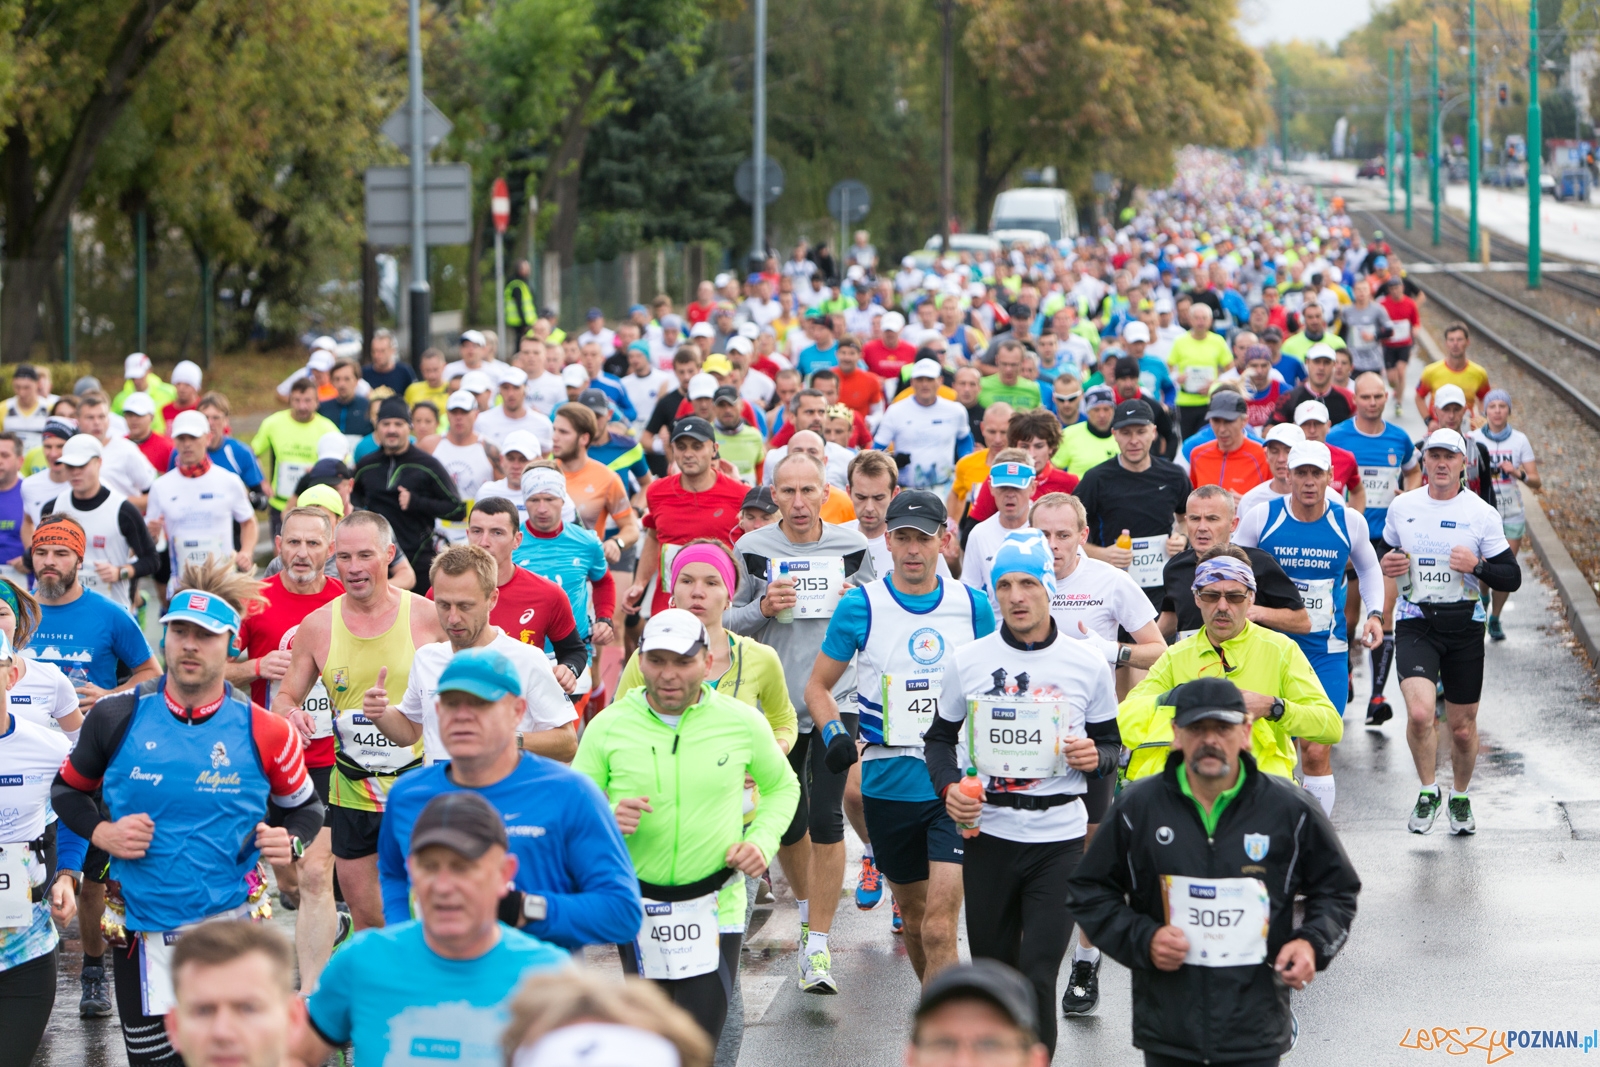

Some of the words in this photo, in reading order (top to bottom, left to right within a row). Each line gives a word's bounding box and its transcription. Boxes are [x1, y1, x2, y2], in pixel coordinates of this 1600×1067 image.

[1274, 546, 1299, 556] TKKF
[1301, 547, 1338, 559] WODNIK
[1132, 553, 1164, 567] 6074
[1279, 557, 1331, 570] WIĘCBORK
[792, 577, 829, 591] 2153
[1418, 571, 1451, 583] 1440
[989, 728, 1043, 745] 6084
[361, 749, 391, 757] Zbigniew
[992, 747, 1039, 757] Przemysław
[129, 766, 163, 786] Rowery
[1188, 907, 1245, 927] 3067
[650, 923, 701, 943] 4900
